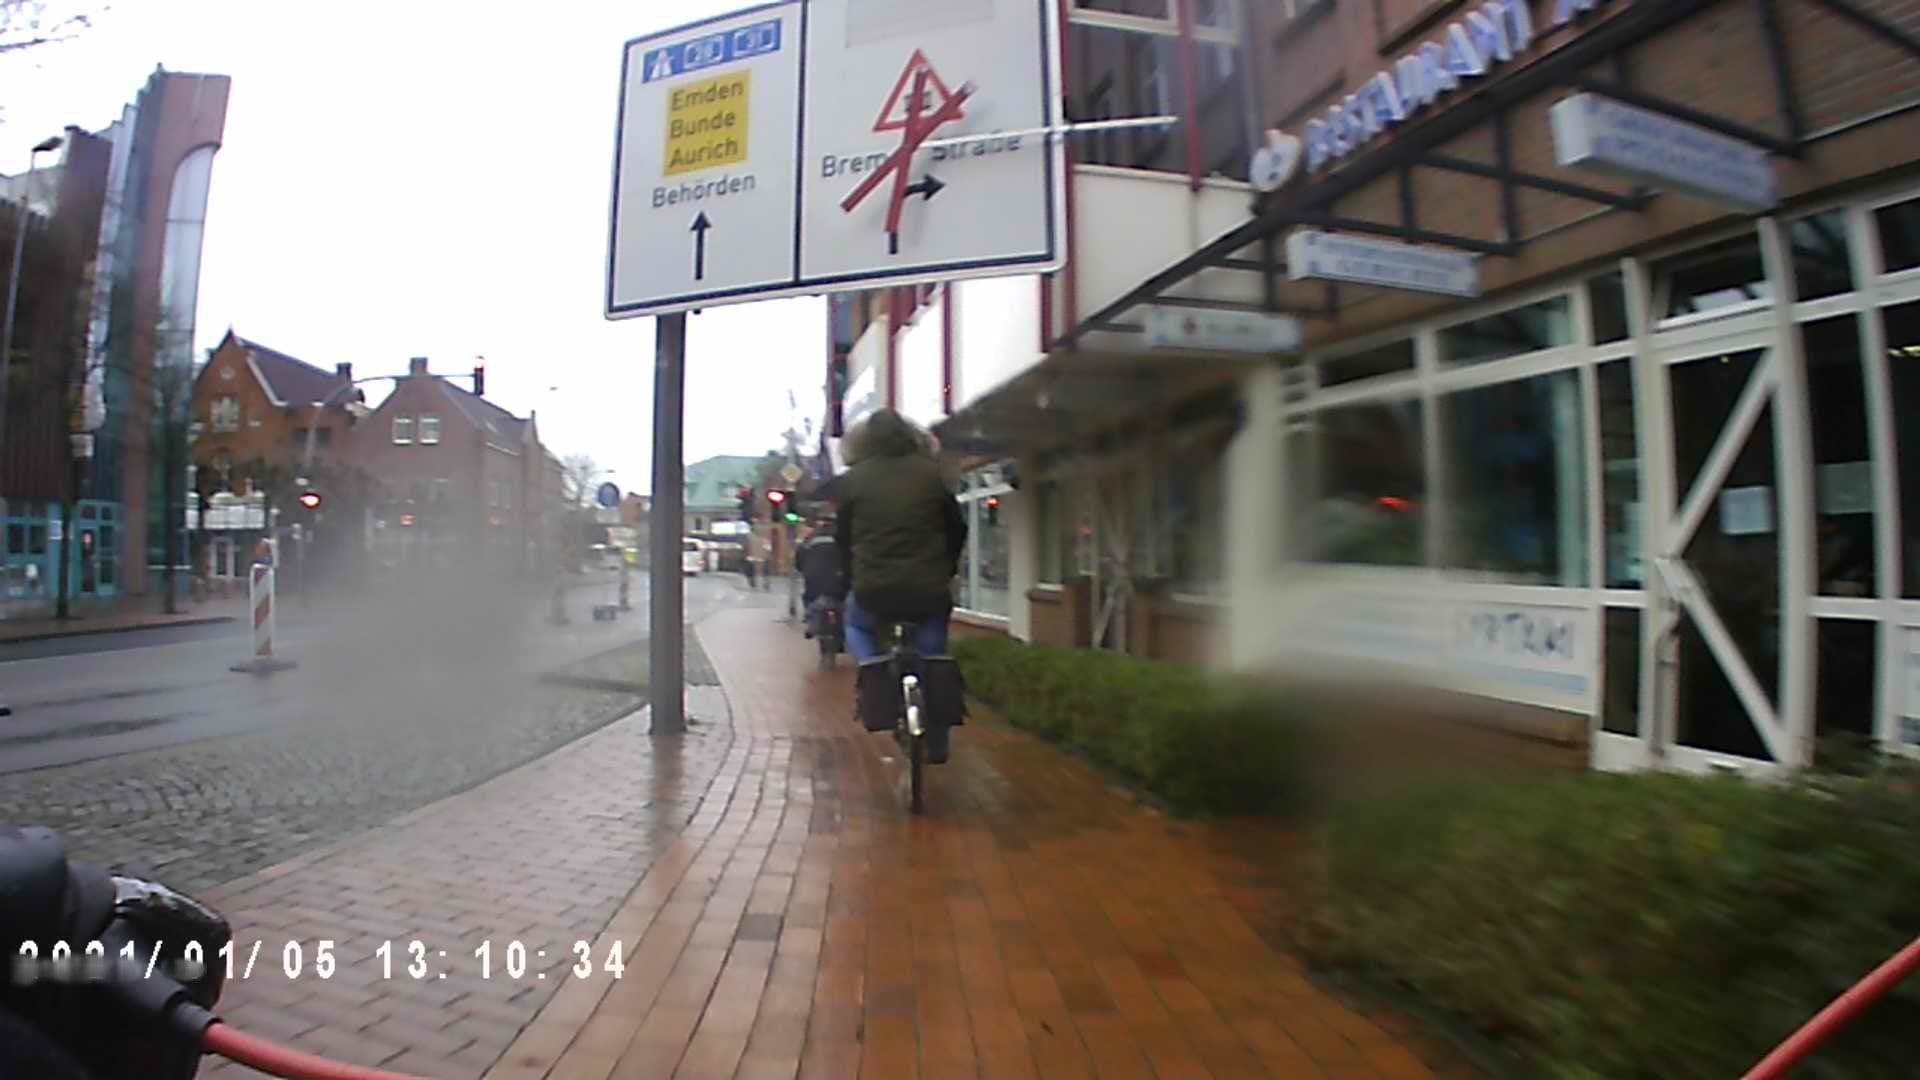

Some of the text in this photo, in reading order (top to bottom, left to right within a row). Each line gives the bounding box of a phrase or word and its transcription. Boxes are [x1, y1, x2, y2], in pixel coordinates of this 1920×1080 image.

[671, 80, 744, 111] Emden
[669, 110, 736, 139] Bunde
[668, 137, 738, 168] Aurich
[652, 173, 756, 208] Behörden
